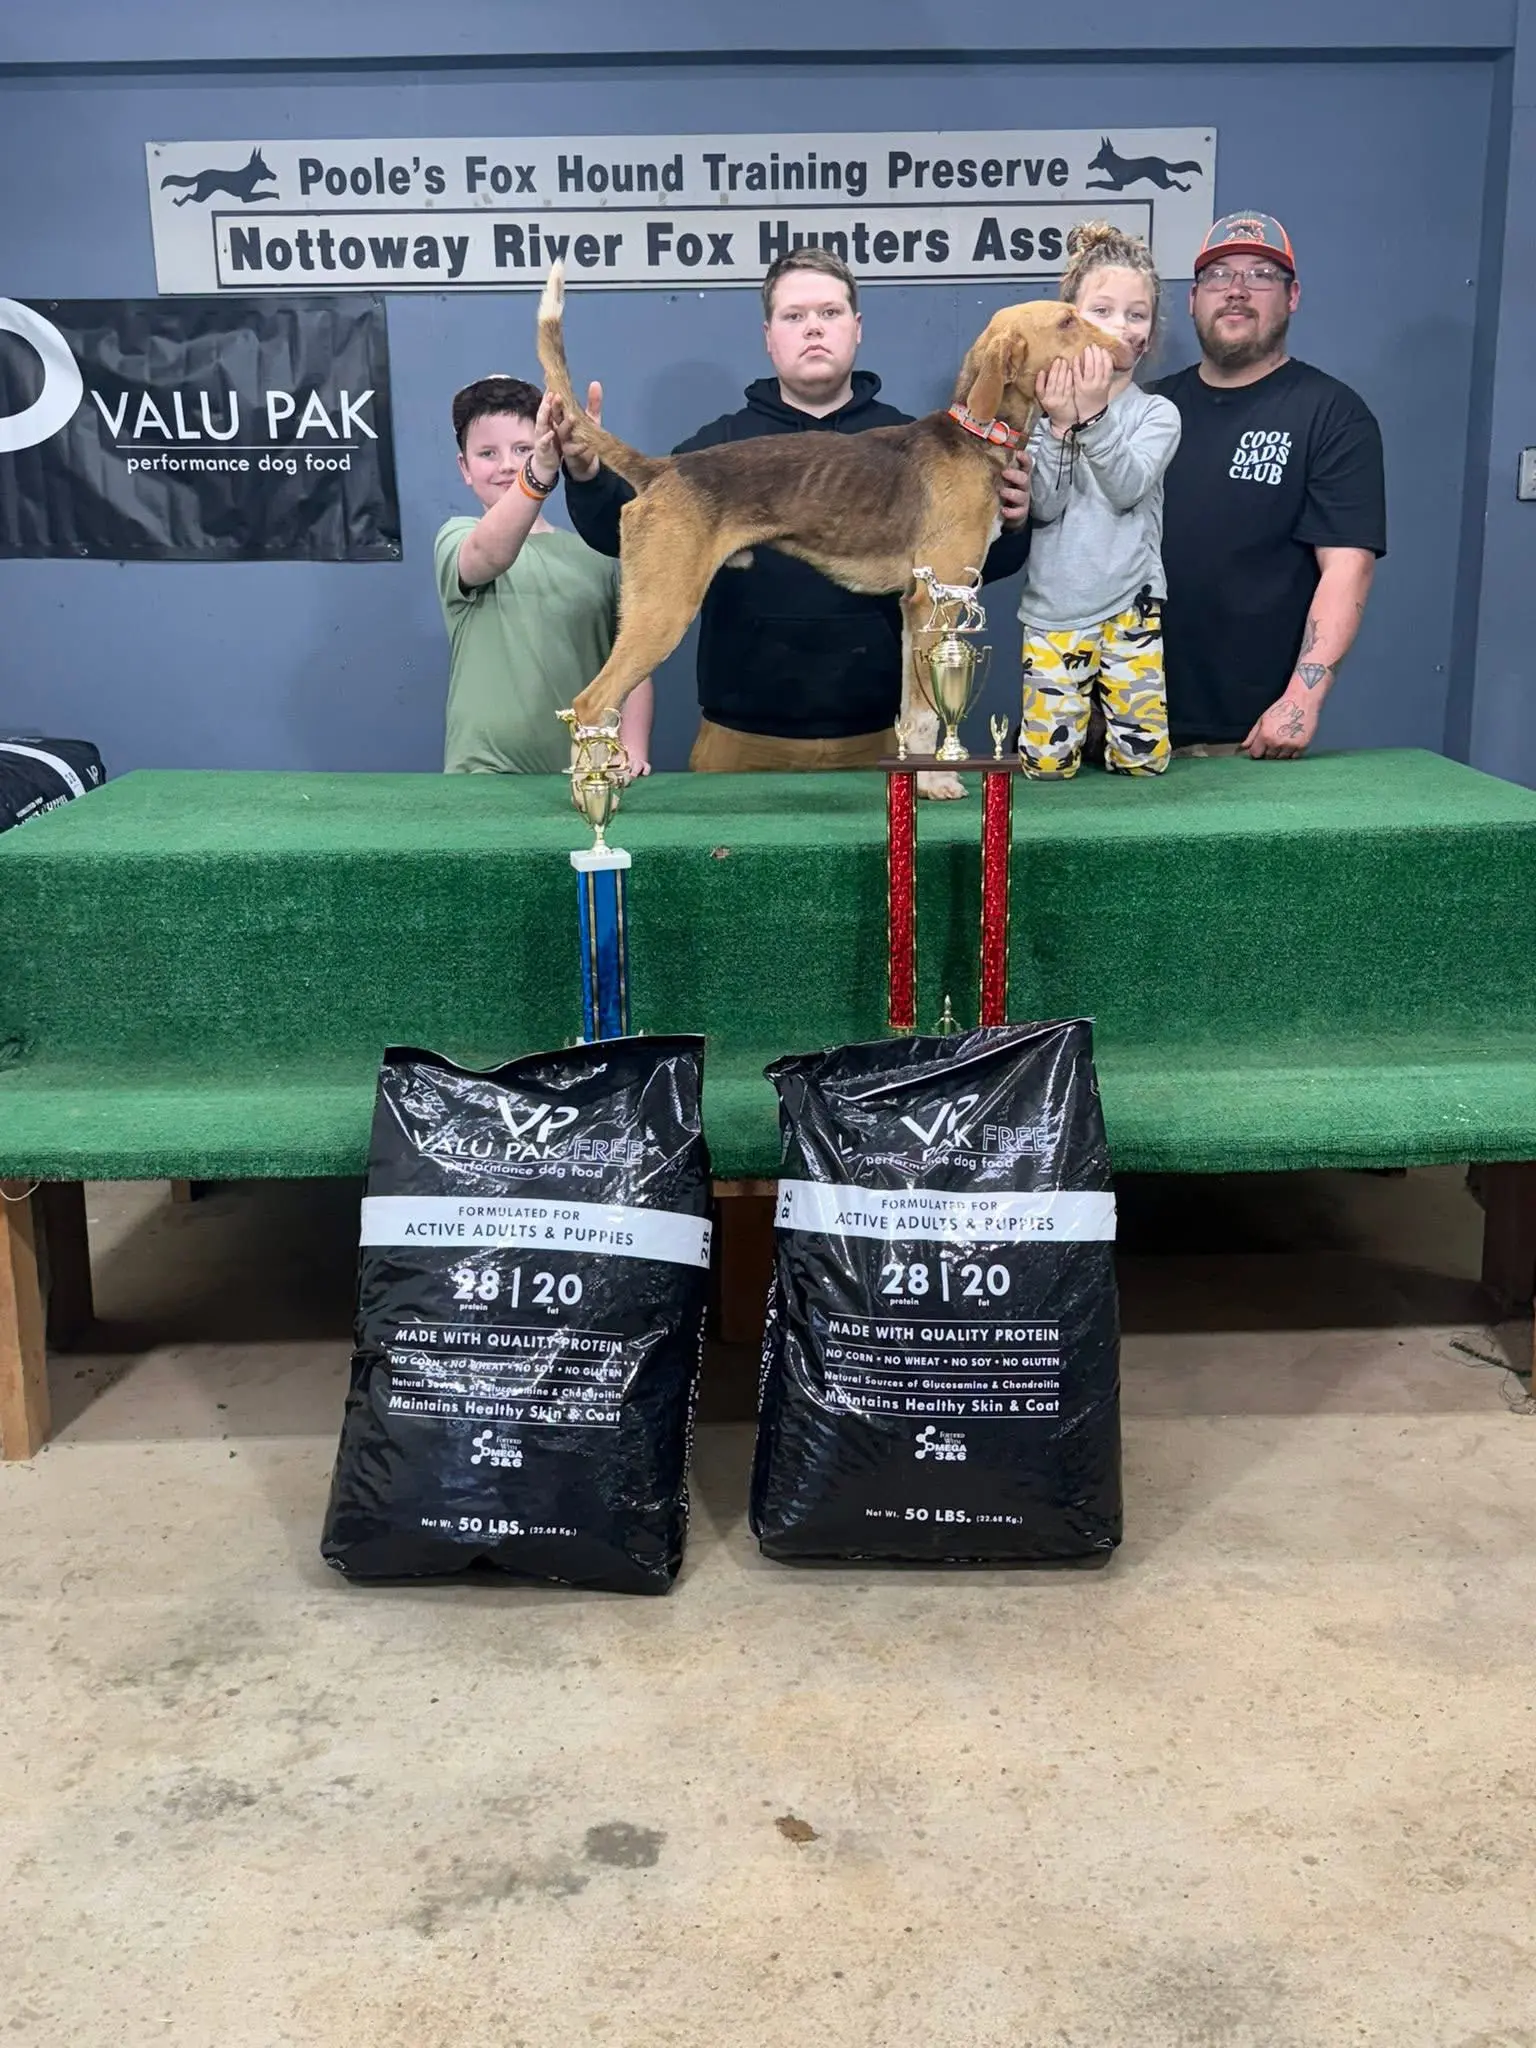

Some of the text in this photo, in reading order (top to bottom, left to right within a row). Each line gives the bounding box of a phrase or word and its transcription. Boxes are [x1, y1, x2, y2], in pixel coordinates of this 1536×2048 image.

[299, 151, 1070, 197] Poole's Fox Hound Training Preserve
[229, 226, 469, 279] Nottoway
[494, 221, 623, 268] River
[647, 220, 734, 267] Fox
[90, 389, 379, 441] VALU PAK
[1240, 430, 1292, 449] COOL
[127, 453, 352, 475] performance dog food
[1232, 445, 1289, 466] DADS
[1228, 463, 1283, 485] CLUB
[497, 1096, 580, 1143] VP
[414, 1130, 643, 1165] VALU PAK FREE
[538, 1164, 566, 1178] dog
[571, 1165, 604, 1178] food
[953, 1153, 977, 1171] dog
[981, 1155, 1014, 1169] food
[458, 1206, 581, 1221] FORMULATED FOR
[971, 1201, 999, 1211] FOR
[835, 1211, 889, 1230] ACTIVE
[896, 1215, 958, 1231] ADULTS
[966, 1218, 976, 1230] &
[404, 1222, 634, 1246] ACTIVE ADULTS & PUPPIES
[452, 1268, 583, 1306] 28 20
[881, 1263, 1011, 1297] 28 20
[459, 1303, 488, 1311] protein
[546, 1306, 560, 1315] fat
[889, 1298, 920, 1306] protein
[978, 1298, 990, 1307] fat
[395, 1329, 623, 1354] MADE WITH QUALITY PROTEIN
[828, 1321, 1060, 1342] MADE WITH QUALITY PROTEIN
[390, 1354, 407, 1365] NO
[450, 1358, 467, 1369] NO
[514, 1362, 531, 1373] NO
[534, 1363, 555, 1374] SOY
[565, 1365, 580, 1376] NO
[583, 1366, 622, 1378] GLUTEN
[826, 1348, 1060, 1368] NO CORN NO WHEAT NO SOY NO GLUTEN
[392, 1376, 425, 1388] Natural
[552, 1388, 559, 1397] &
[824, 1370, 1060, 1391] Natural Sources of Glucosamine & Chondroitin
[388, 1395, 459, 1413] Maintains
[465, 1400, 524, 1419] Healthy
[585, 1408, 622, 1423] Coat
[825, 1389, 1060, 1415] Maintains Healthy Skin & Coat
[925, 1442, 967, 1453] OMEGA
[934, 1451, 967, 1461] 3&6
[490, 1457, 522, 1468] 3&6
[421, 1518, 437, 1528] Net
[458, 1516, 483, 1532] 50
[489, 1519, 525, 1536] LBS.
[865, 1508, 882, 1517] Net
[904, 1508, 929, 1521] 50
[935, 1509, 972, 1524] LBS.
